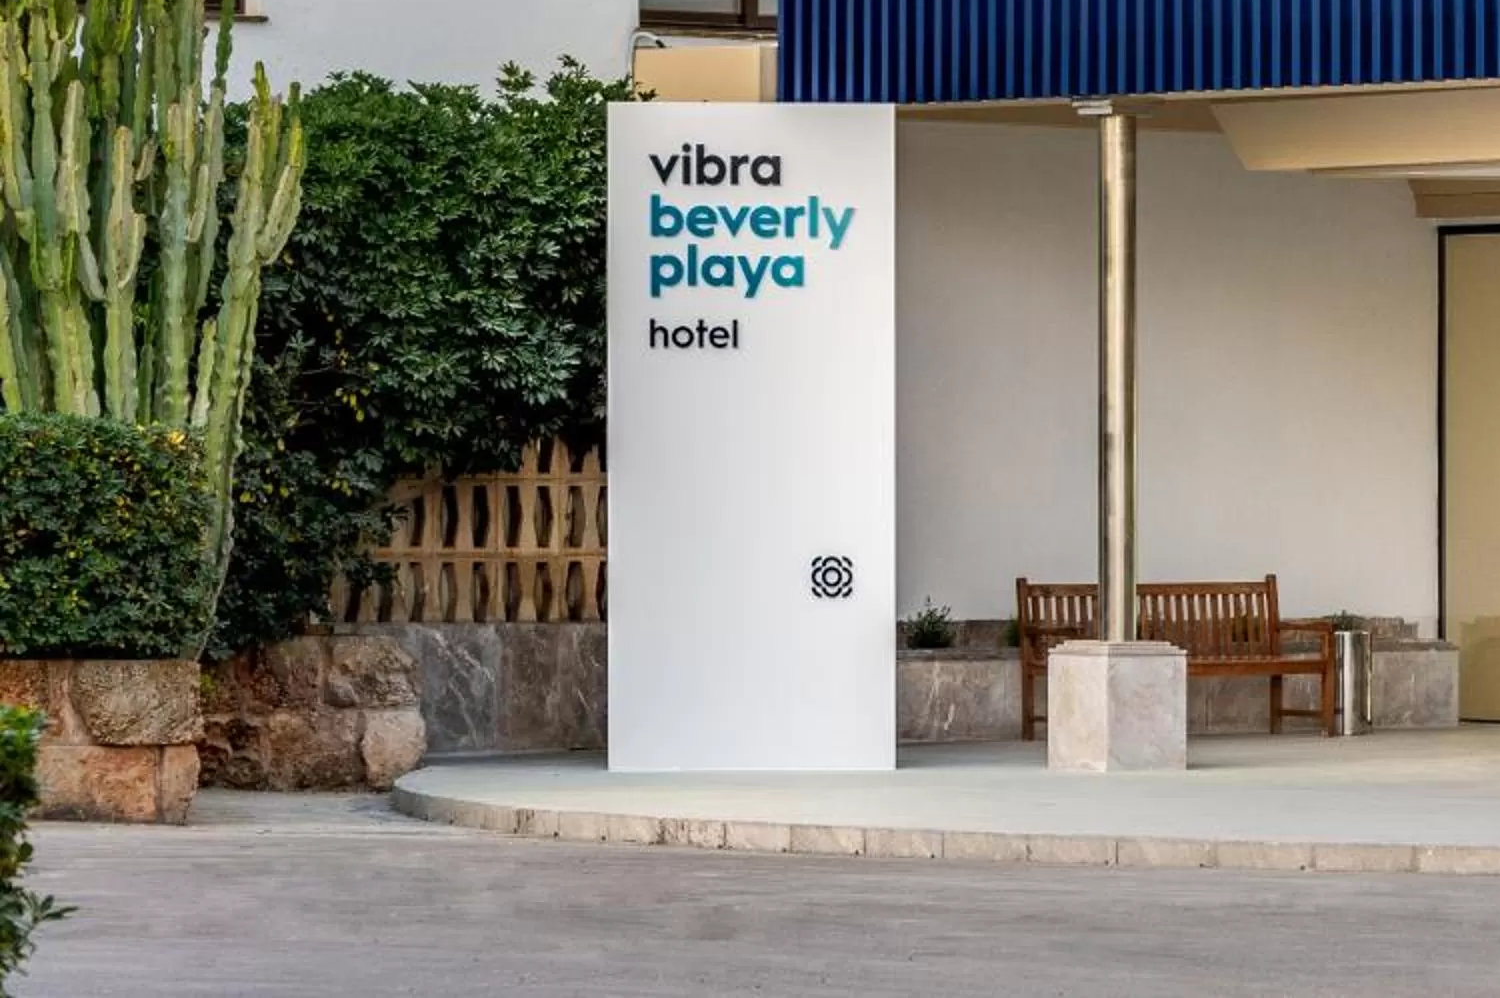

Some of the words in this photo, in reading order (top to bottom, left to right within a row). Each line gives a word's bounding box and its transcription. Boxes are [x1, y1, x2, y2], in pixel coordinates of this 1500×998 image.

[648, 142, 782, 187] vibra
[649, 193, 855, 250] beverly
[649, 243, 806, 299] playa
[649, 317, 739, 350] hotel
